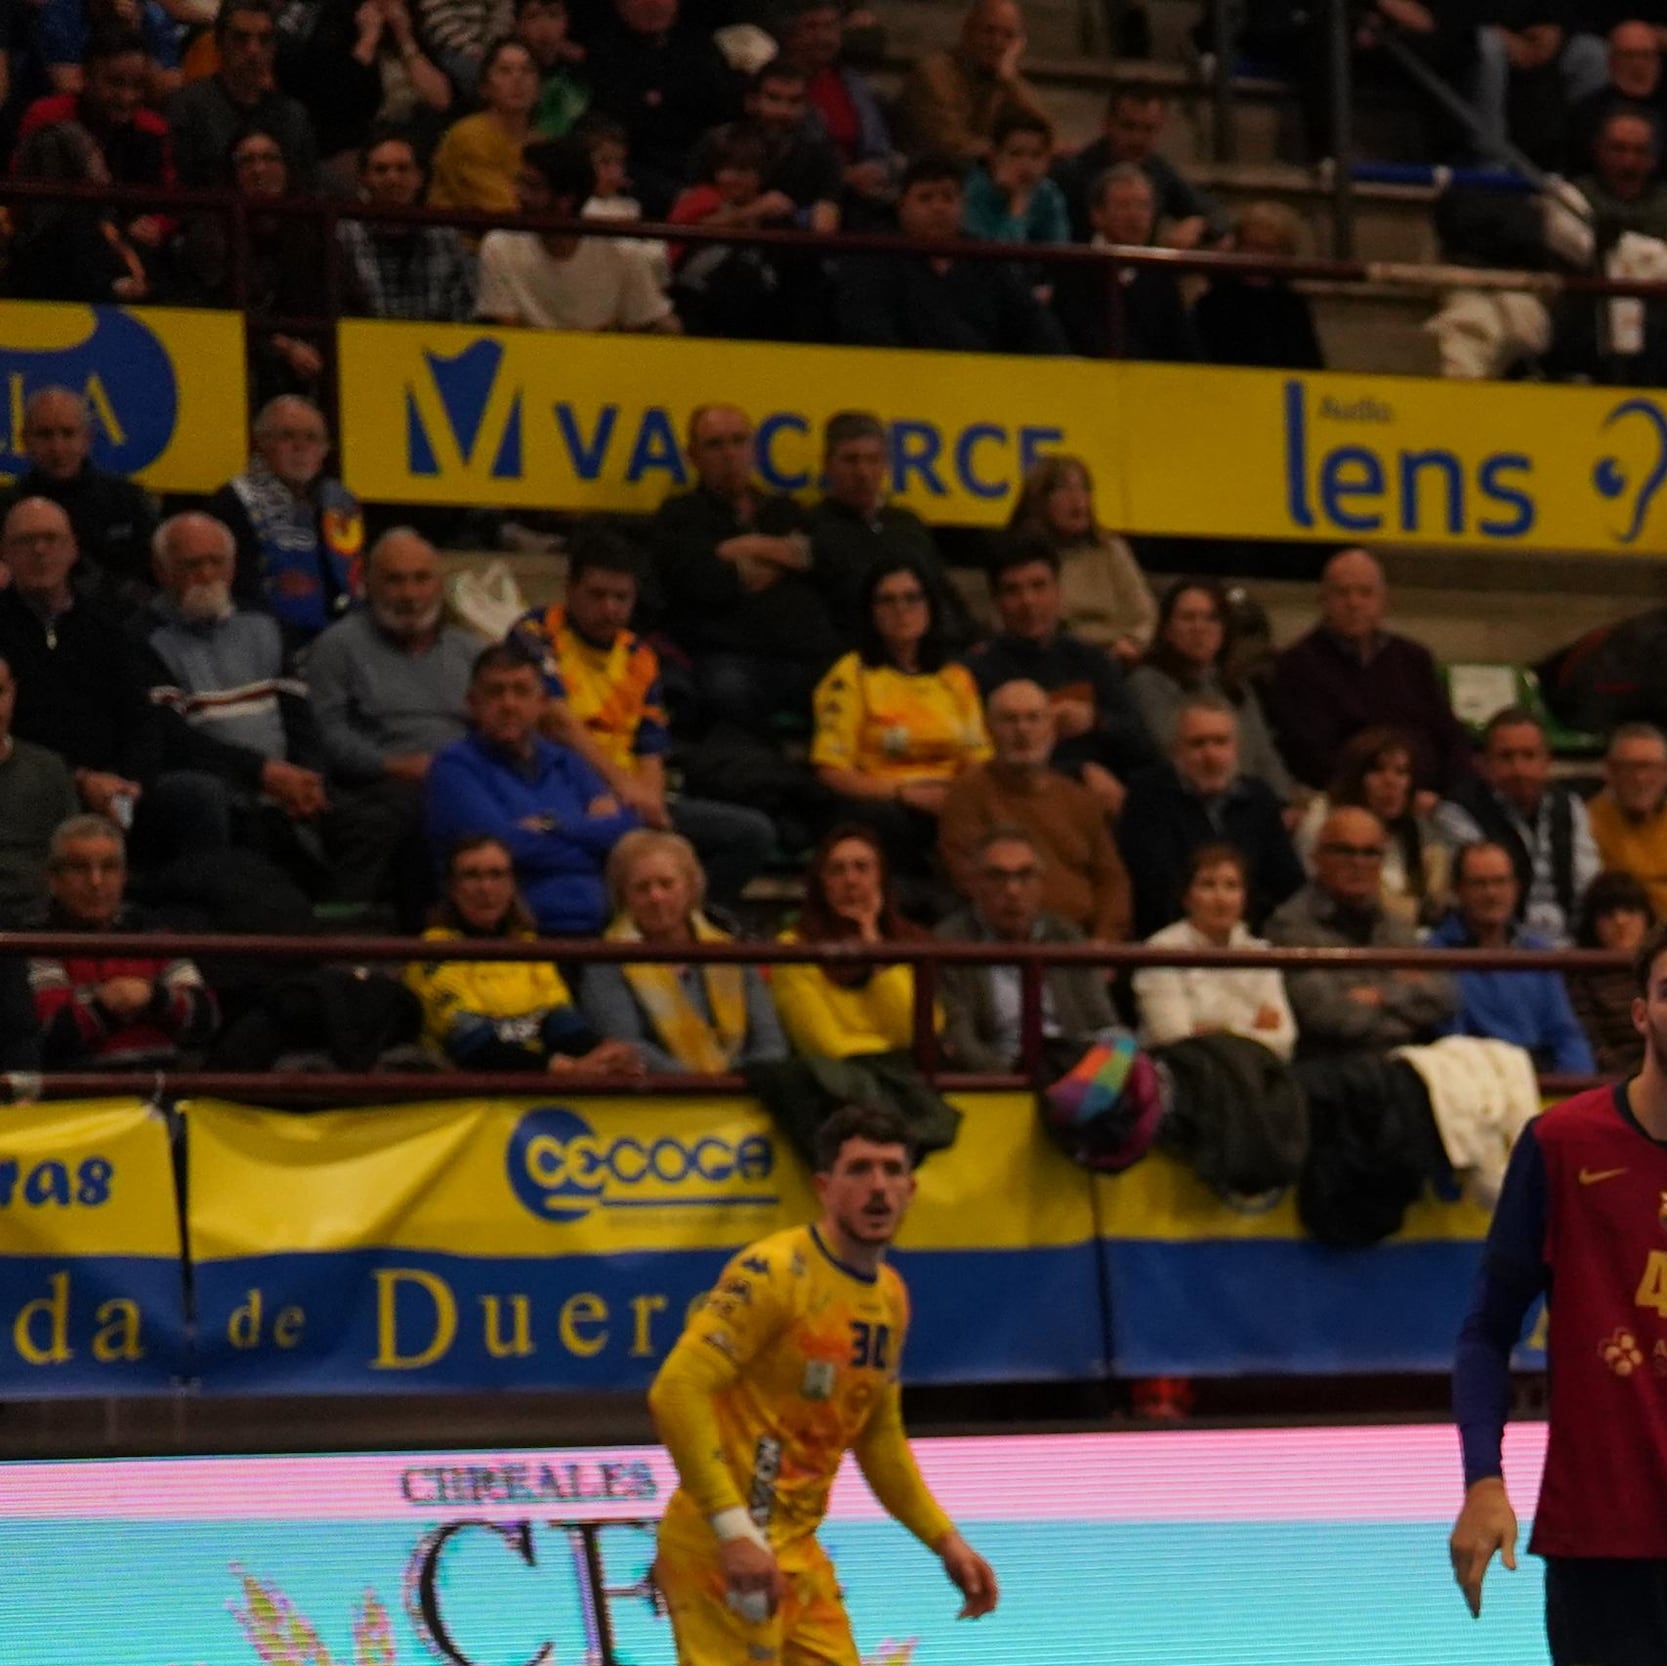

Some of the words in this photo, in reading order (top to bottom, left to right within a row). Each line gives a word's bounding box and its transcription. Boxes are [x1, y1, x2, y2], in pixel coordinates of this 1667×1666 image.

[1285, 378, 1537, 536] lens
[226, 1287, 306, 1349] de
[368, 1266, 712, 1370] Duer
